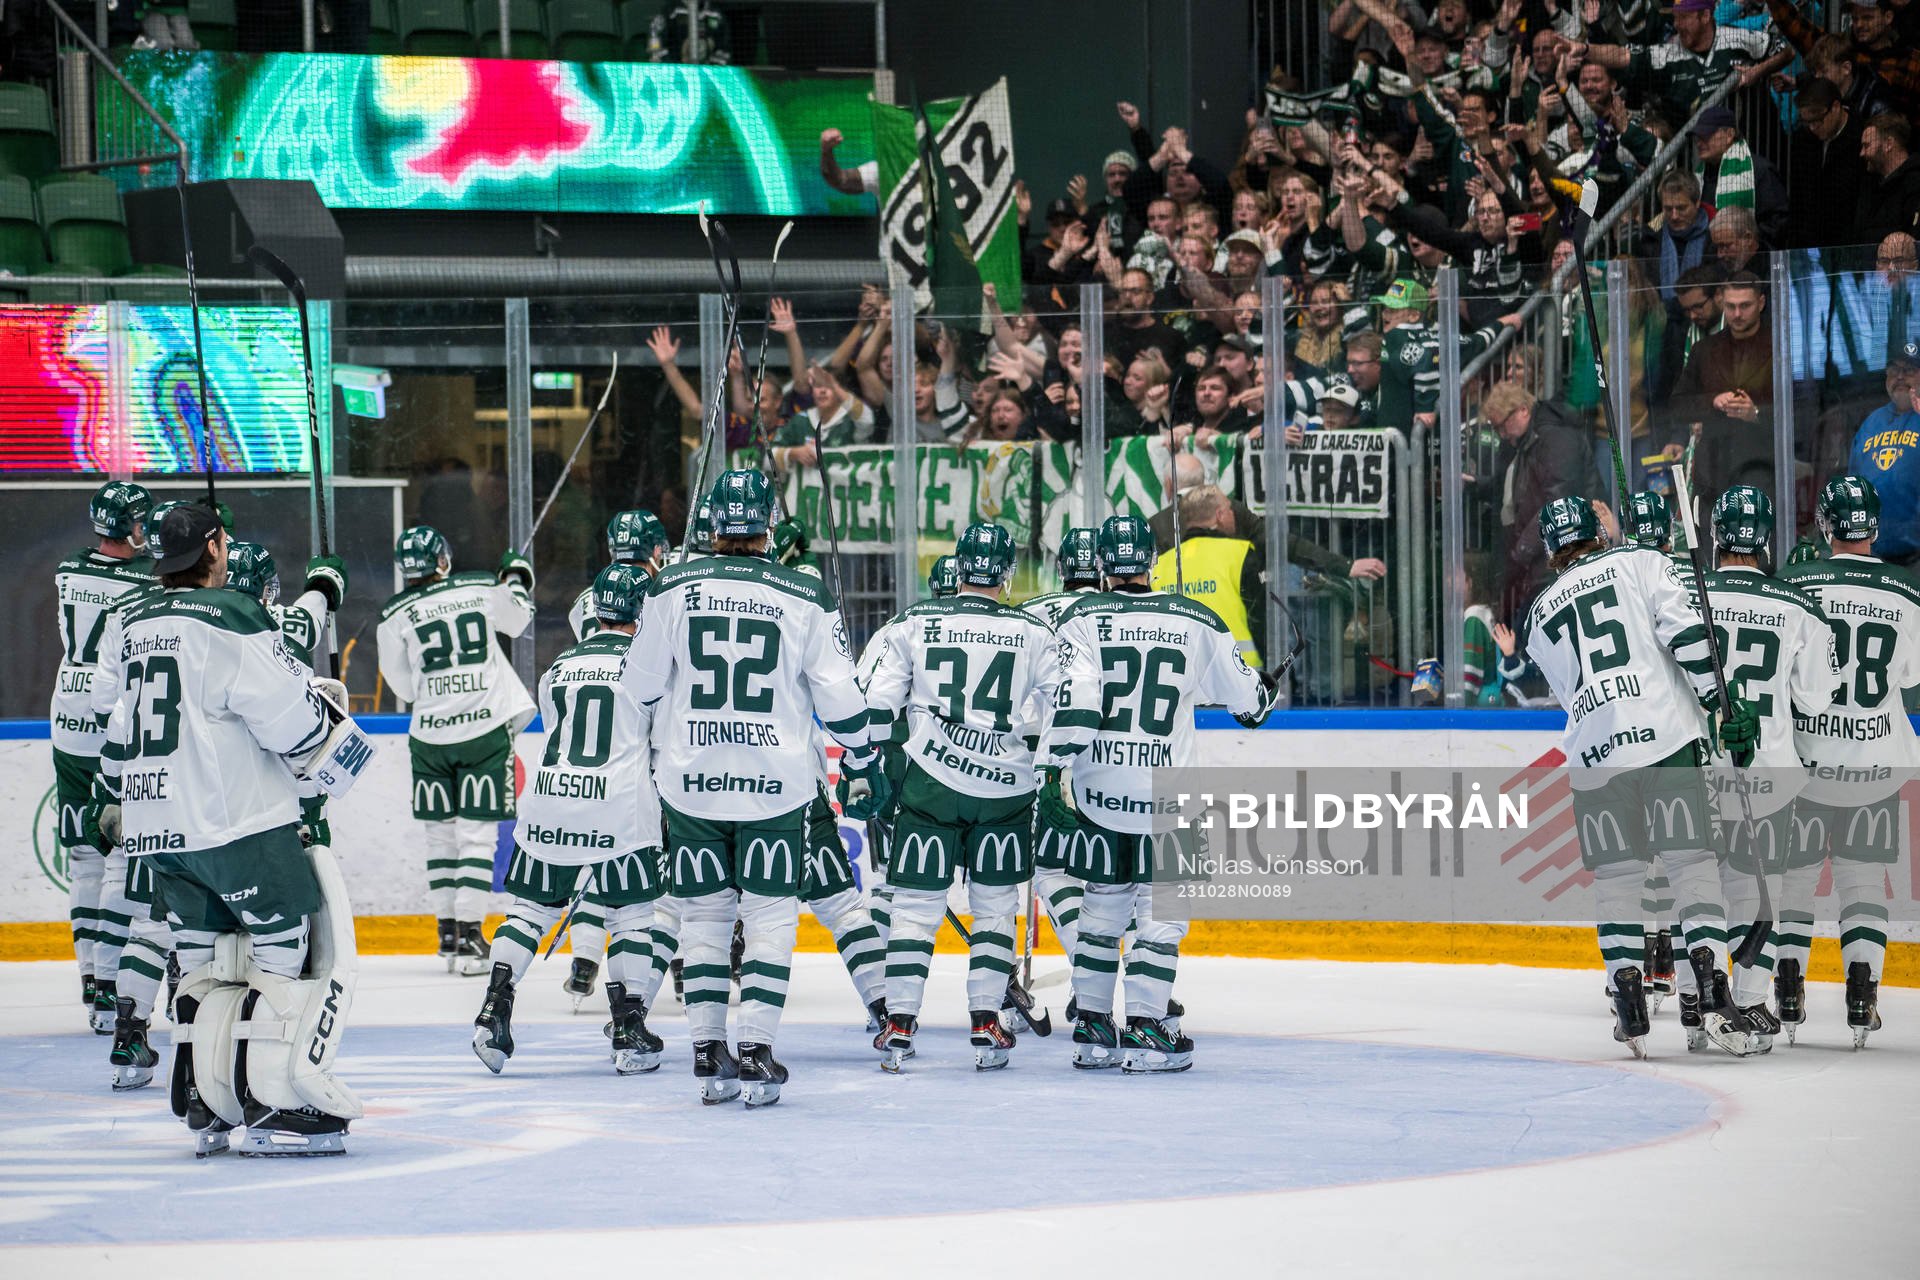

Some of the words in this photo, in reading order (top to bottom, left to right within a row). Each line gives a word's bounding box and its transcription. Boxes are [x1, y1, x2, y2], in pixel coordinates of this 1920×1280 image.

[1321, 434, 1384, 450] CARLSTAD
[1863, 430, 1919, 453] SVERIGE
[96, 507, 107, 519] 14
[728, 503, 744, 515] 52
[1851, 510, 1867, 523] 28
[1554, 514, 1569, 528] 75
[1638, 523, 1652, 534] 22
[617, 531, 630, 542] 20
[697, 531, 709, 541] 63
[1739, 527, 1754, 538] 32
[1077, 550, 1091, 561] 59
[1118, 543, 1133, 555] 26
[975, 556, 989, 569] 34
[661, 567, 715, 585] Schaktmiljö
[724, 565, 754, 573] CCM
[762, 571, 817, 597] Schaktmiljö
[943, 575, 952, 586] 11
[1784, 573, 1836, 584] haktmiljö
[1844, 571, 1872, 579] CCM
[602, 591, 613, 603] 10
[1548, 567, 1618, 611] Infrakraft
[1725, 578, 1753, 586] CCM
[1761, 583, 1814, 608] Schaktmiljö
[171, 599, 222, 617] Schaktmiljö
[425, 597, 484, 619] Infrakraft
[707, 595, 785, 621] Infrakraft
[962, 602, 989, 610] CCM
[1169, 602, 1217, 627] Schaktmiljö
[1710, 607, 1786, 628] Infrakraft
[416, 611, 488, 674] 29
[947, 629, 1025, 649] Infrakraft
[1541, 584, 1631, 693] 75
[562, 667, 622, 682] Infrakra
[688, 615, 782, 714] 52
[427, 672, 488, 696] FORSELL
[925, 647, 1017, 733] 34
[1100, 646, 1187, 737] 26
[1572, 673, 1641, 724] GROLEAU
[541, 684, 615, 768] 10
[687, 720, 780, 747] TORNBERG
[1091, 739, 1173, 767] NYSTRÖM
[1581, 726, 1656, 770] Helmia
[922, 738, 1017, 786] Helmia
[1800, 757, 1892, 783] Helmia
[122, 768, 169, 802] AGACÉ
[534, 770, 607, 800] NILSSON
[682, 772, 783, 795] Helmia
[1086, 788, 1181, 815] Helmia
[526, 823, 616, 849] Helmia
[221, 886, 258, 902] CCM
[308, 978, 344, 1066] CCM
[117, 1041, 123, 1049] 7
[696, 1052, 707, 1061] 52
[741, 1056, 752, 1065] 52
